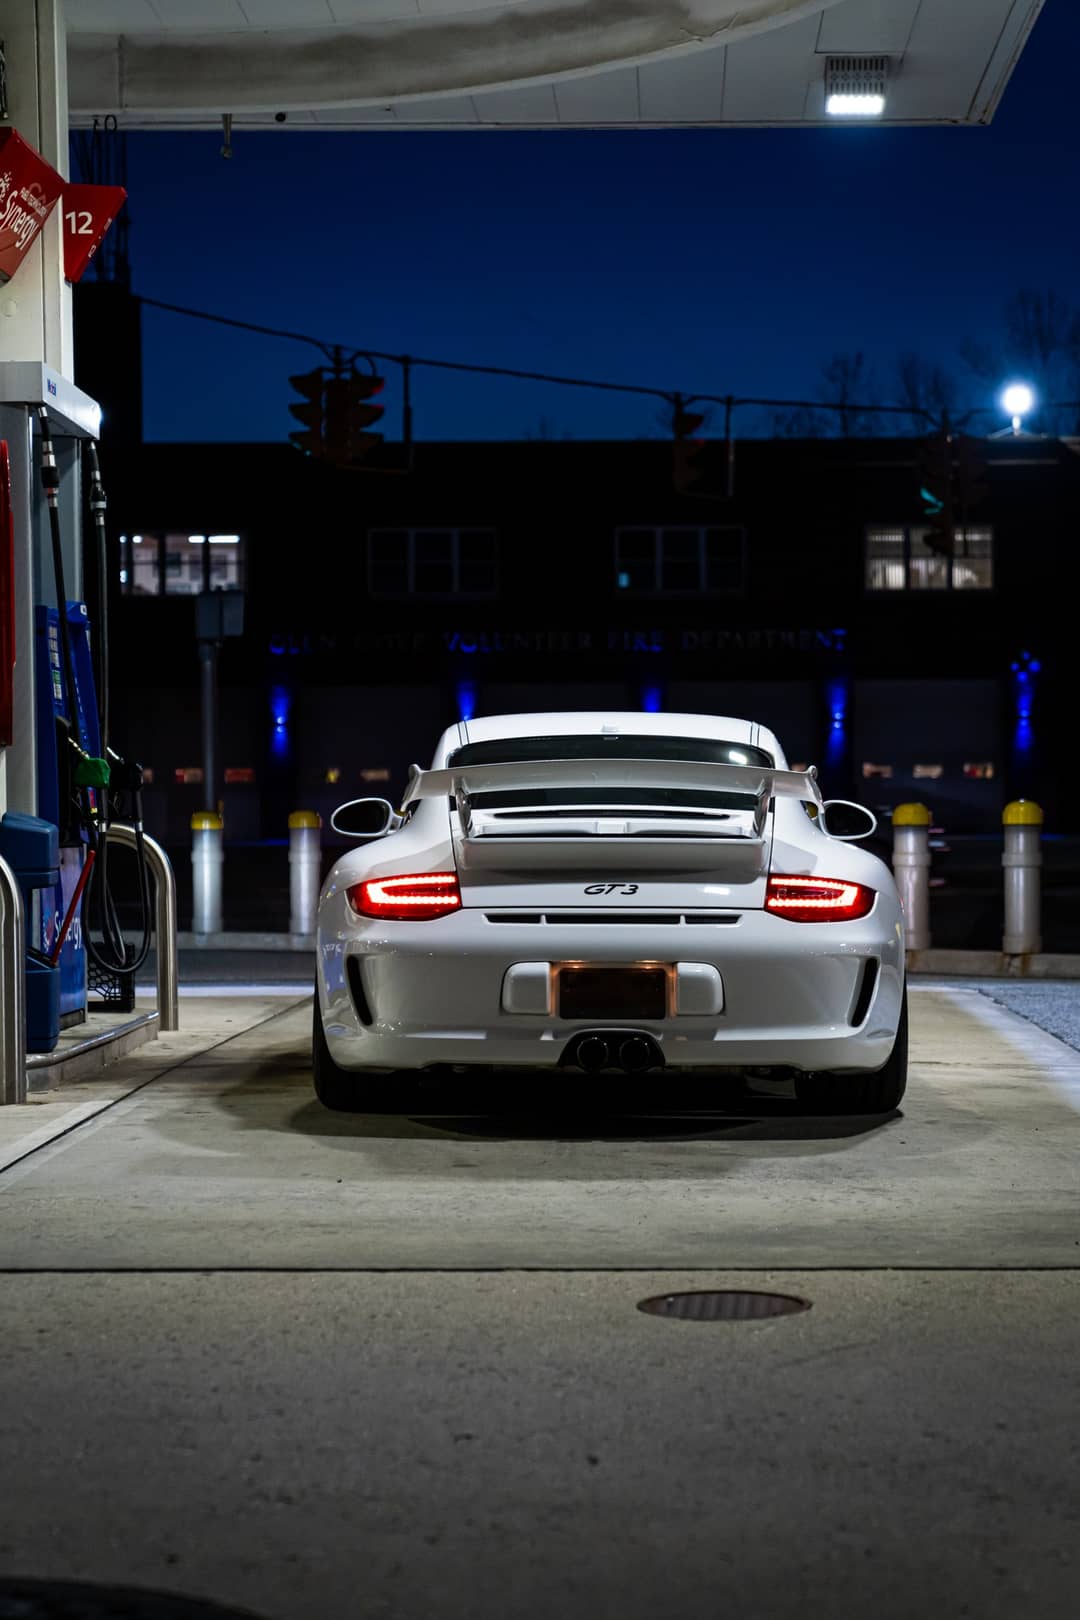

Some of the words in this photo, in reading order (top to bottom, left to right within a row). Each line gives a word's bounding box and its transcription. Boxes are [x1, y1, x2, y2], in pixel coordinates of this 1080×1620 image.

[0, 190, 39, 251] Synergy
[65, 210, 94, 235] 12
[584, 884, 639, 895] GT3
[54, 911, 82, 953] Syergy
